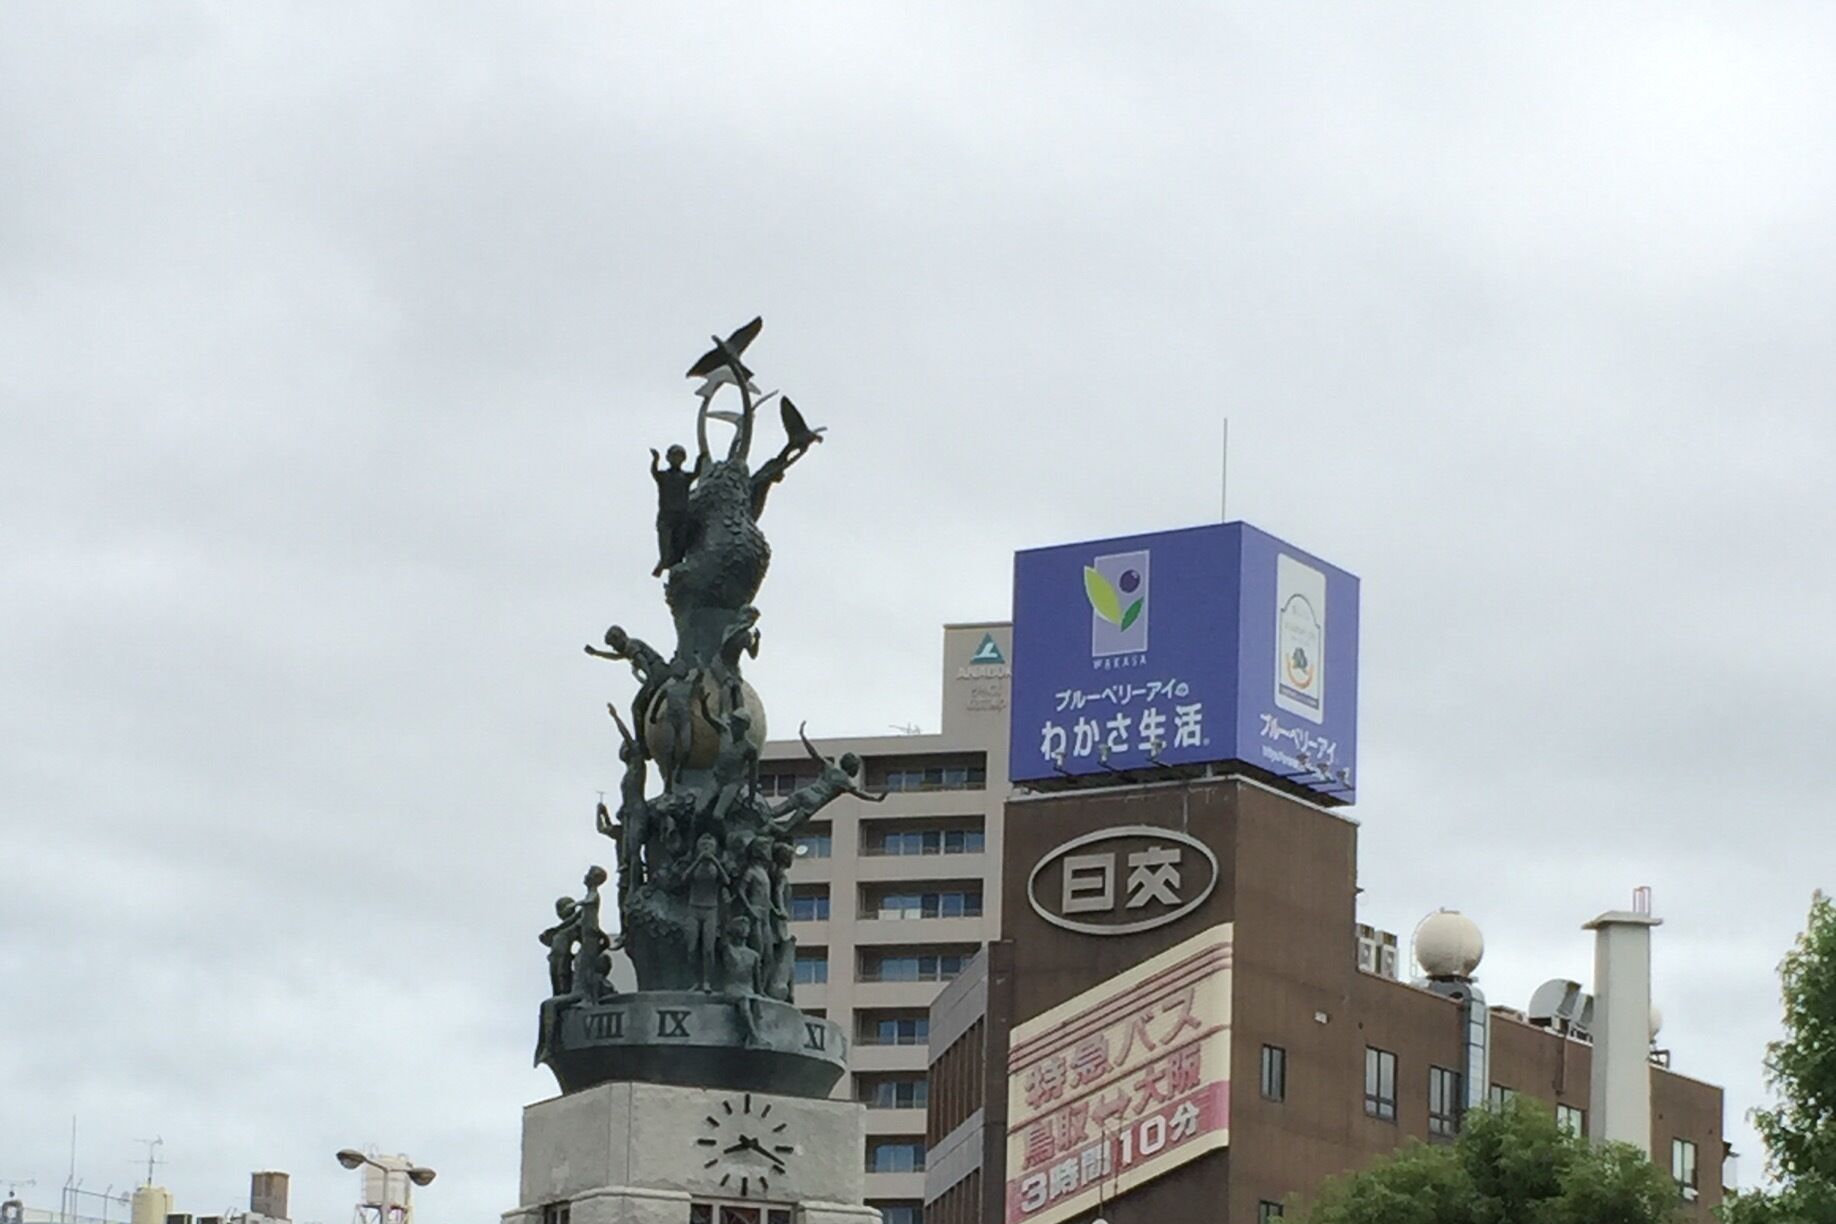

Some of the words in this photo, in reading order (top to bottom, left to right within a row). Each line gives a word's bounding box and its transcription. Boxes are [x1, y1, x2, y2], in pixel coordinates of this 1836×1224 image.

[1093, 654, 1147, 670] WAKASA
[1055, 678, 1189, 711] ブルーベリーアイの
[1041, 703, 1202, 760] わかさ生活
[1062, 846, 1184, 915] 日交
[657, 1010, 692, 1038] IX
[1024, 987, 1203, 1111] 特急バス
[1131, 1045, 1202, 1114] 大阪
[1020, 1101, 1200, 1215] 3時間10分
